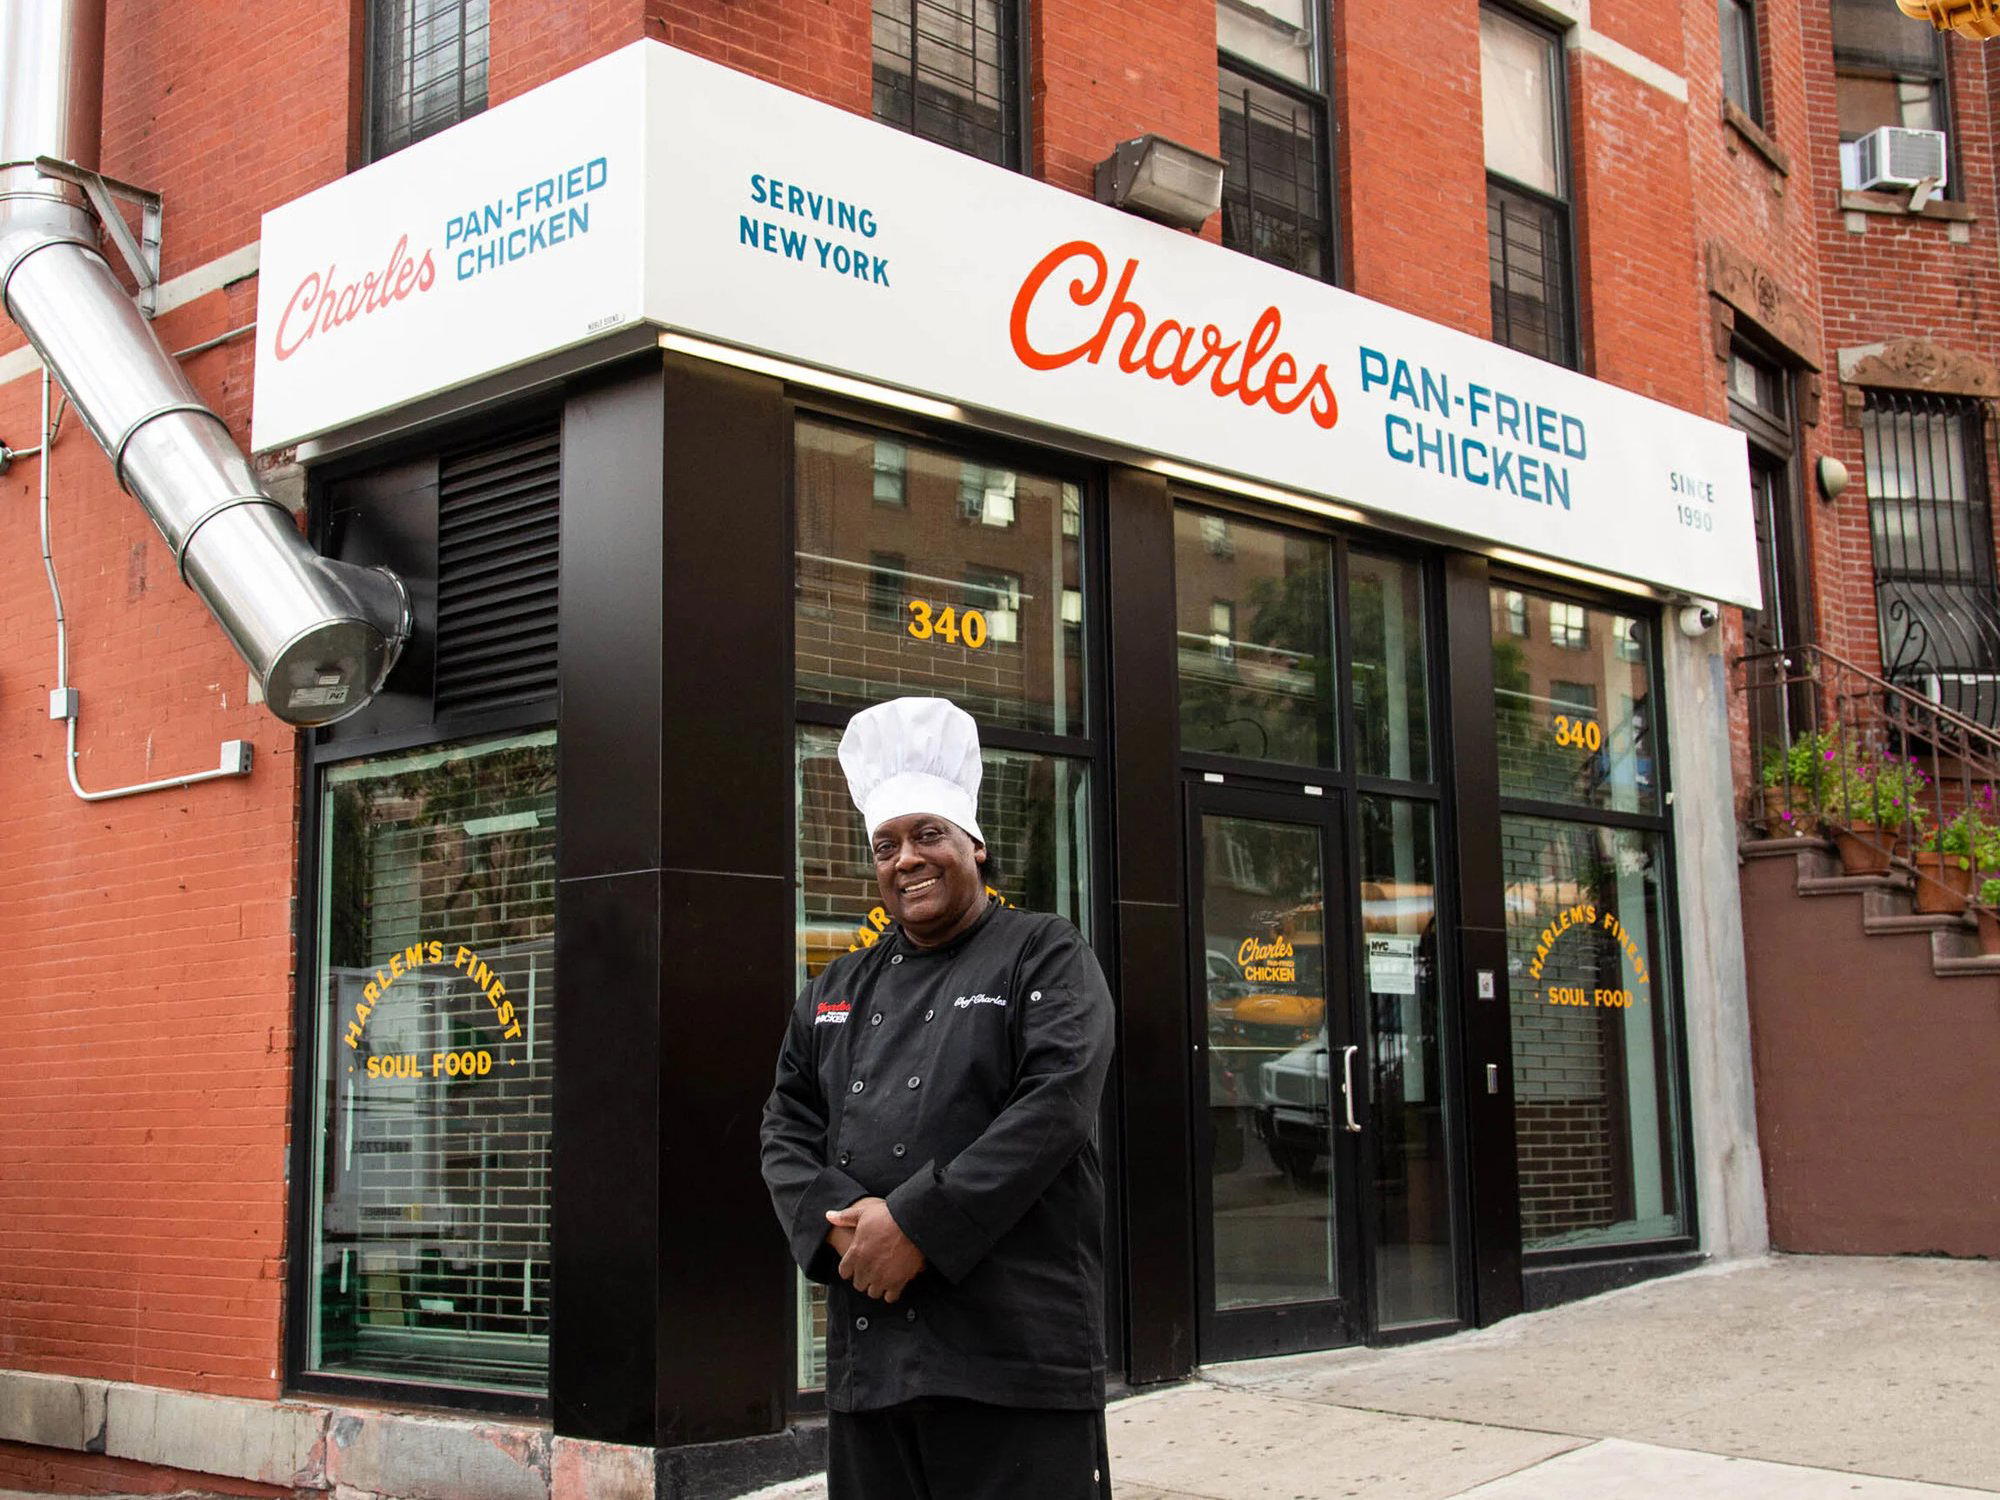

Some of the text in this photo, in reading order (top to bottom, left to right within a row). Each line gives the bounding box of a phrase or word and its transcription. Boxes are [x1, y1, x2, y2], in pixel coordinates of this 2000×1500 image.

[445, 156, 608, 249] PAN-FRIED
[750, 173, 878, 239] SERVING
[456, 202, 590, 281] CHICKEN
[739, 214, 890, 287] NEW YORK
[275, 234, 435, 361] Charles
[1010, 239, 1339, 430] Charles
[1359, 345, 1587, 460] PAN-FRIED
[1384, 412, 1571, 510] CHICKEN
[1670, 472, 1714, 503] SINCE
[1678, 504, 1712, 533] 1990
[907, 599, 987, 649] 340
[1553, 715, 1602, 752] 340
[1237, 935, 1294, 967] Charles
[1244, 966, 1296, 983] CHICKEN
[1371, 940, 1389, 951] NYC
[1529, 904, 1650, 984] HARLEM'S FINEST
[344, 940, 523, 1049] HARLEM'S FINEST
[1546, 986, 1634, 1009] SOUL FOOD
[366, 1050, 493, 1079] SOUL FOOD
